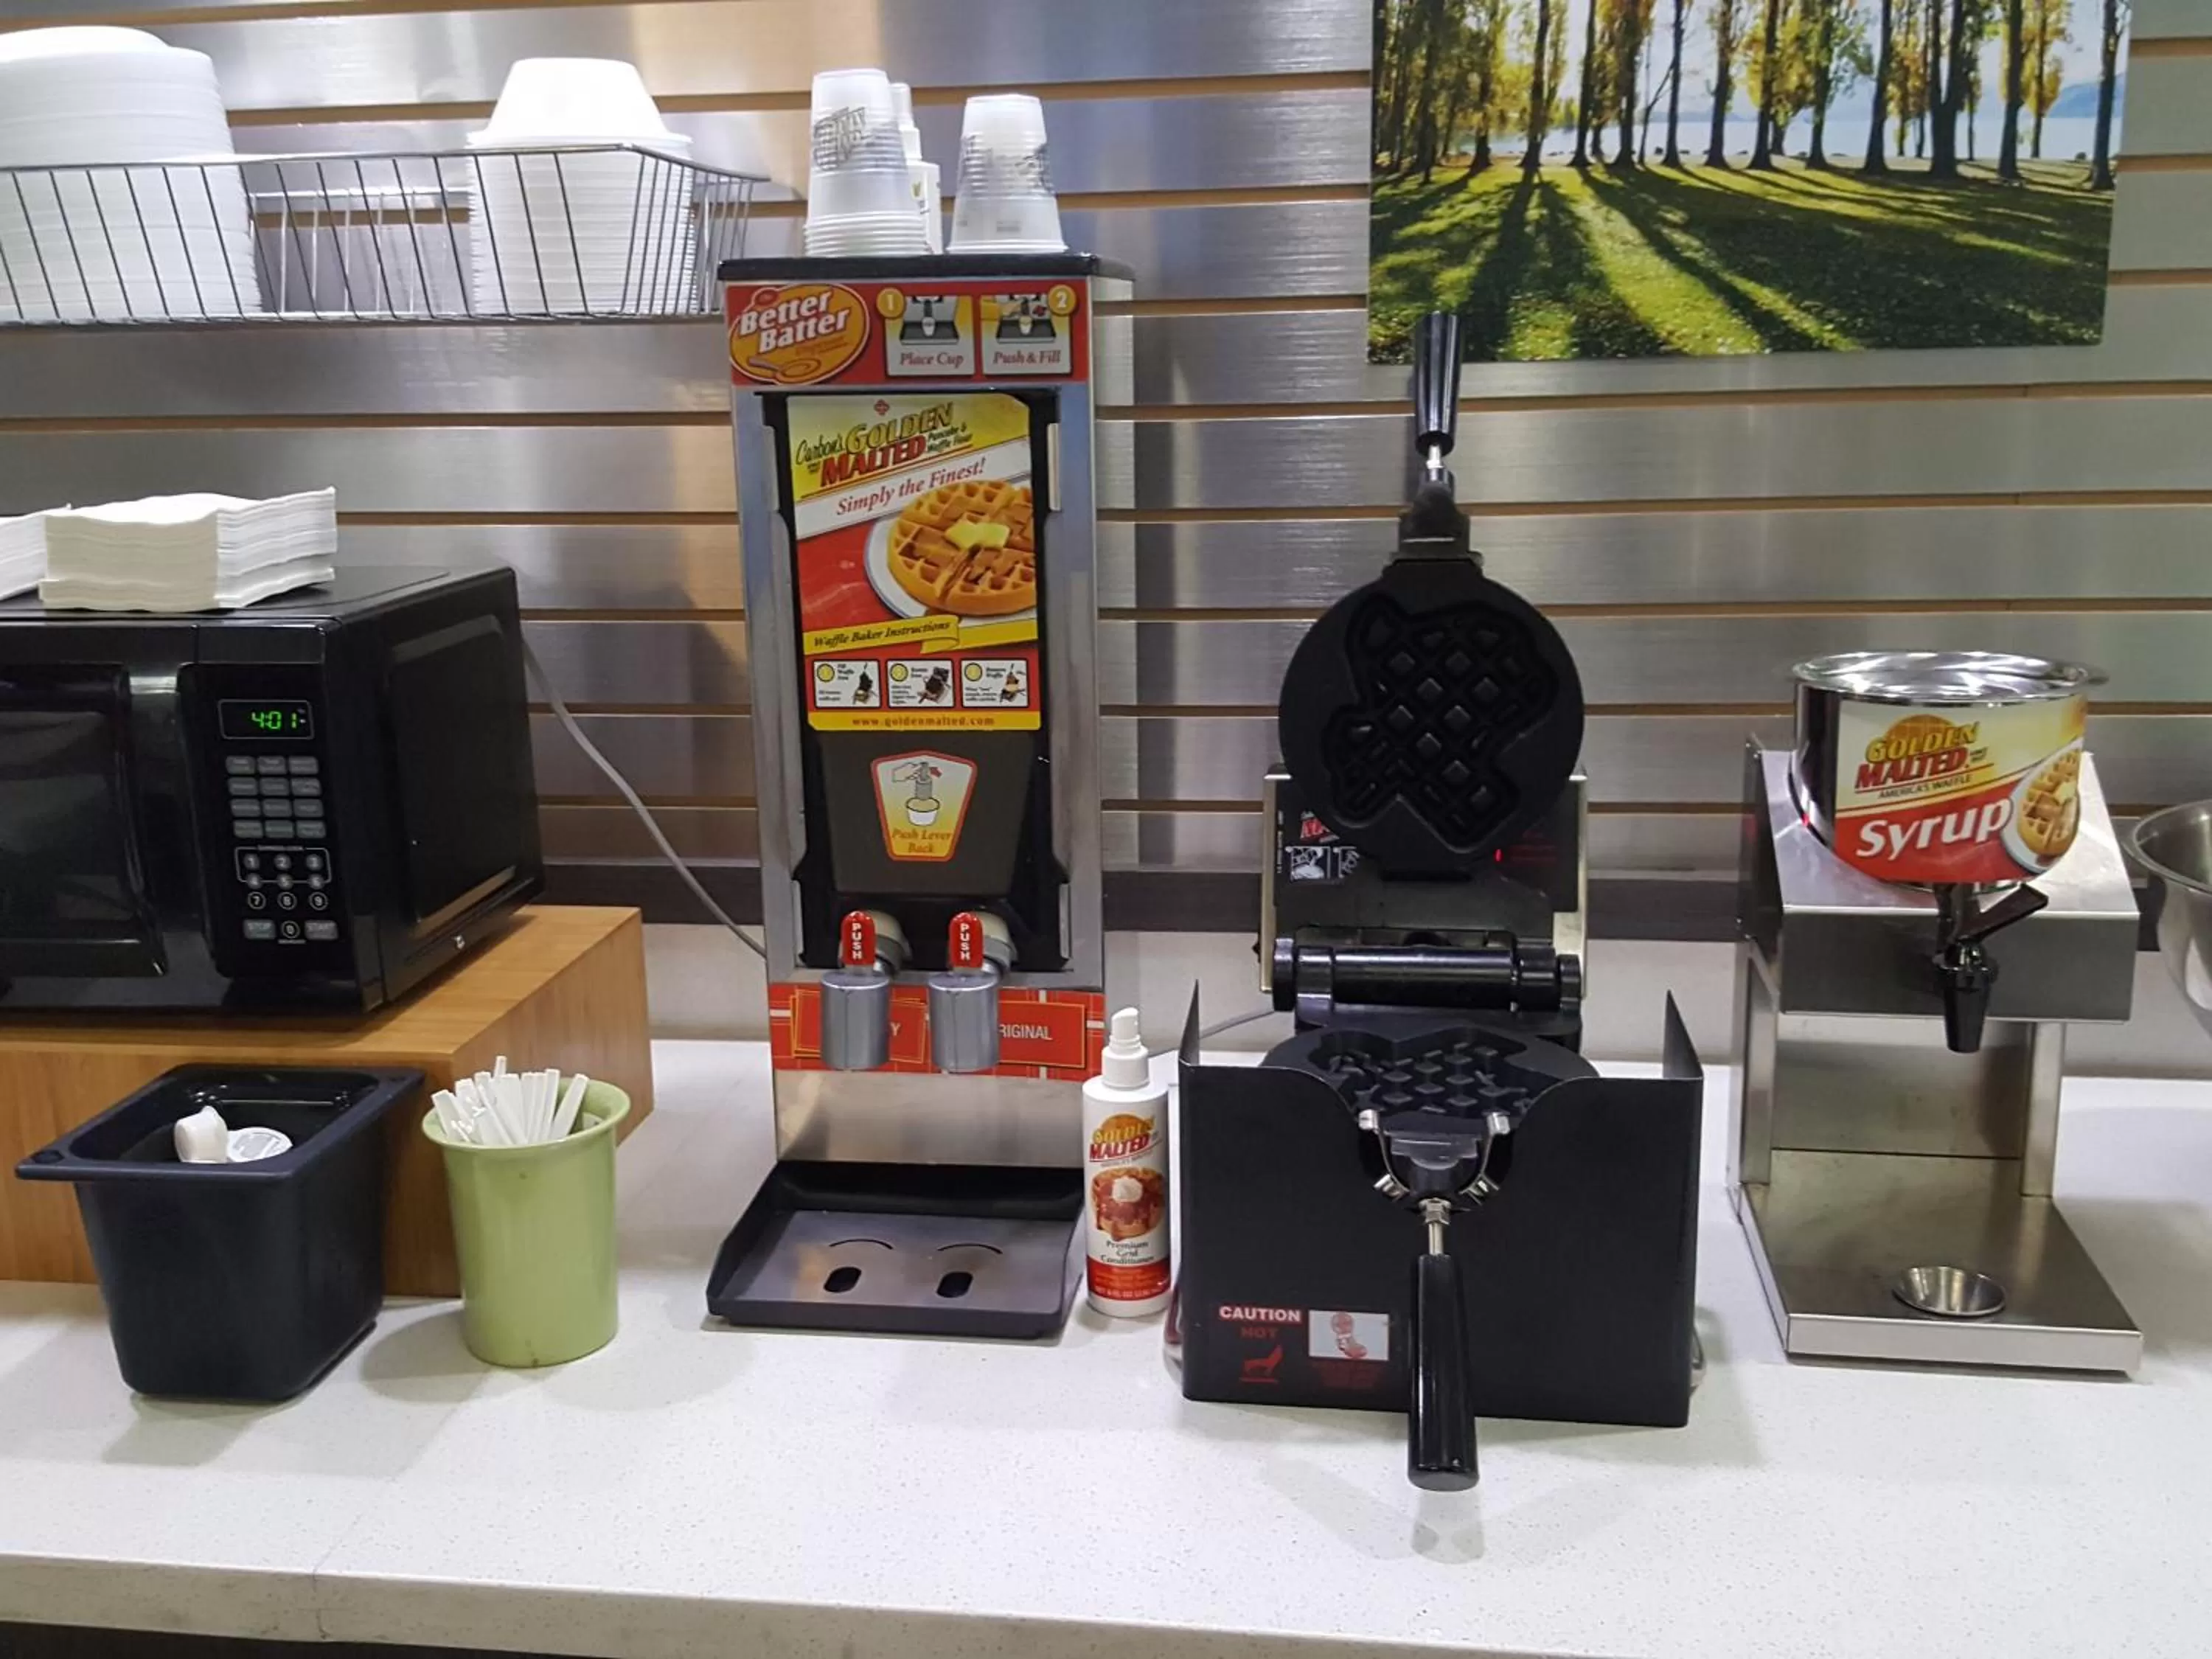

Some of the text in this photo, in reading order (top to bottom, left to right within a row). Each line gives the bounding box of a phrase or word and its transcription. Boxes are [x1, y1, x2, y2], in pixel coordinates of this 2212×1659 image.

[740, 291, 832, 335] Better
[887, 294, 894, 311] 1
[1056, 291, 1068, 308] 2
[759, 310, 850, 353] Batter
[900, 352, 964, 367] Place Cup
[993, 349, 1061, 364] Push & Fill
[846, 402, 953, 455] GOLDEN
[821, 435, 926, 487] MALTED
[837, 456, 987, 515] Simply the Finest!
[814, 621, 950, 647] Waffle Baker Instructions
[251, 710, 297, 731] 4:01
[852, 715, 995, 728] www.goldenmalted.com
[1865, 720, 1980, 764] GOLDEN
[1854, 747, 1969, 789] MALTED
[1855, 798, 2011, 861] Syrup
[852, 922, 862, 960] PUSH
[960, 923, 970, 961] PUSH
[999, 1023, 1054, 1041] RIGINAL
[1219, 1306, 1301, 1322] CAUTION
